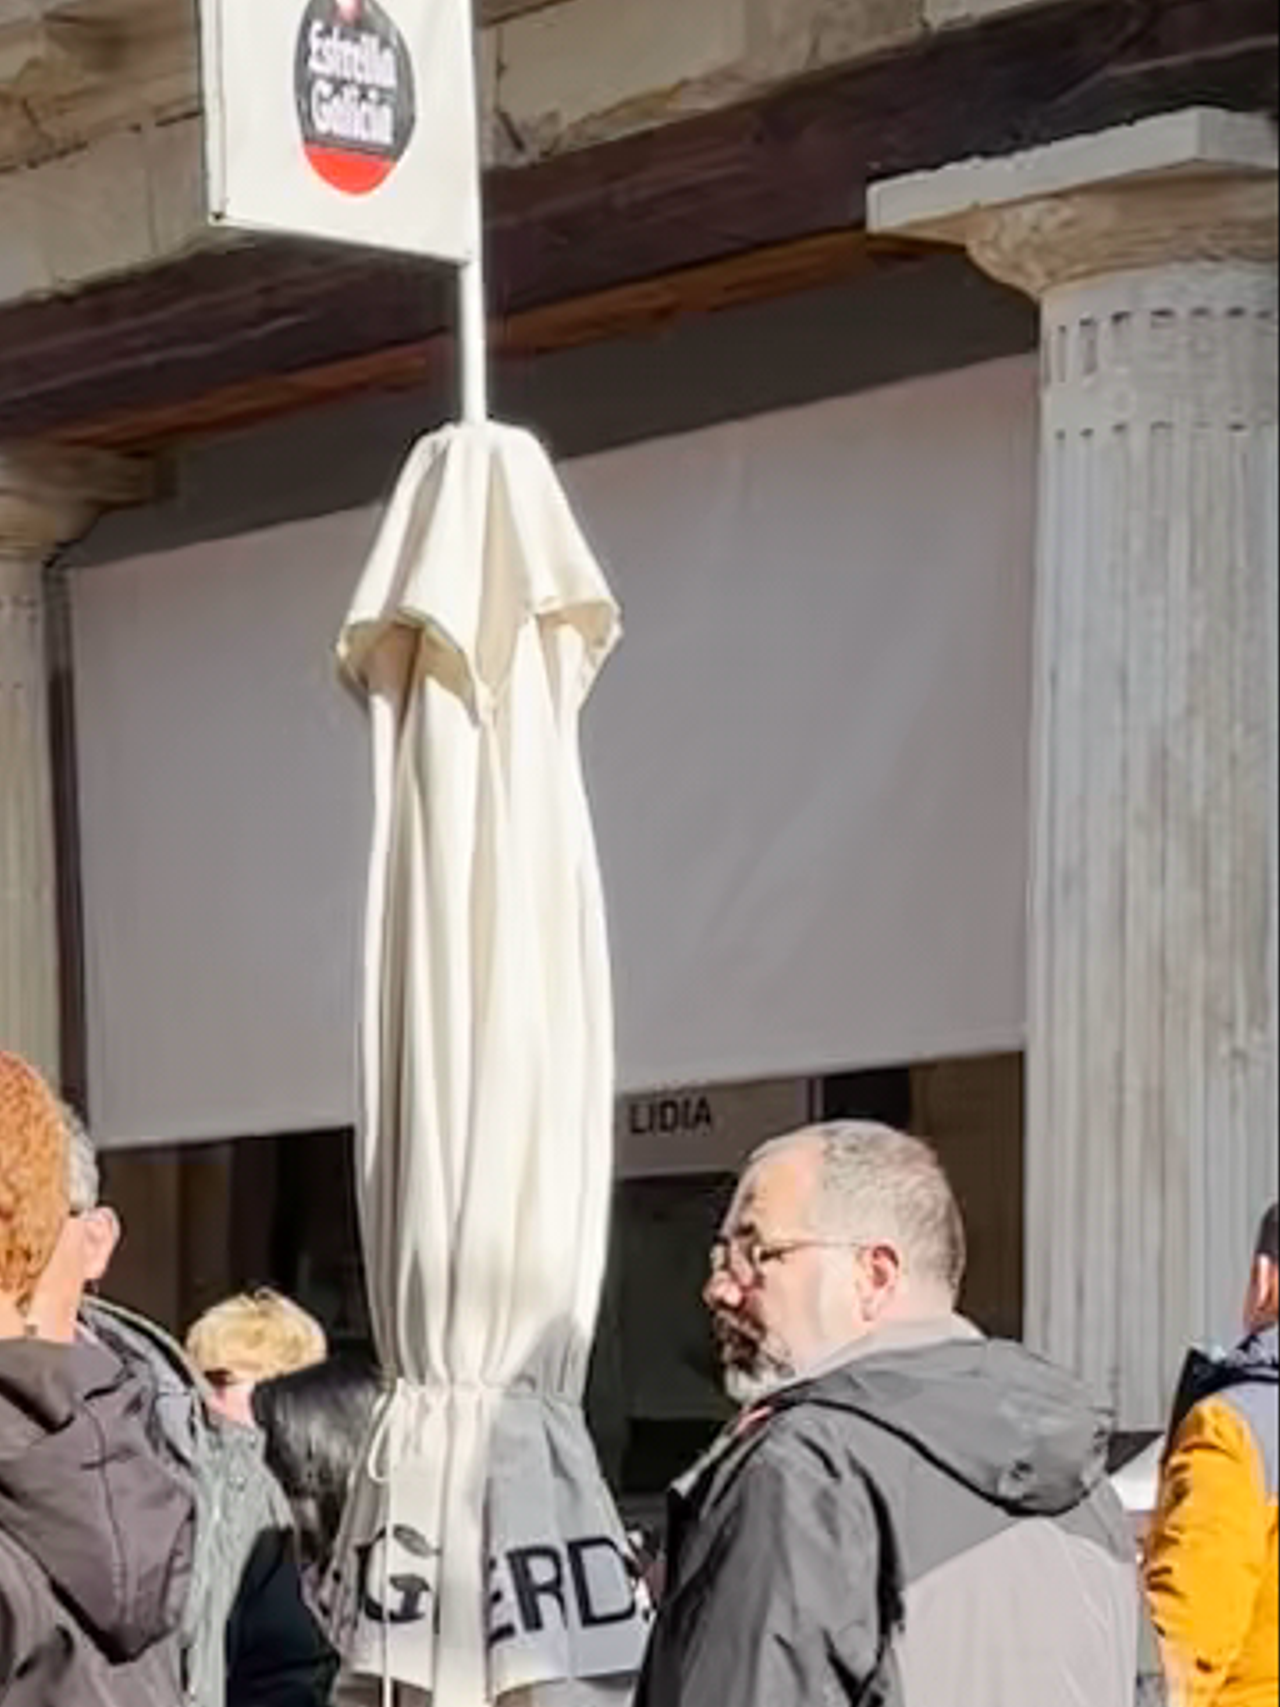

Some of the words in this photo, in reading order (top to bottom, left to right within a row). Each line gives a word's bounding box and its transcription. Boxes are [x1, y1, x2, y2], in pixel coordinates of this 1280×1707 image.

[307, 20, 398, 90] Estrella
[309, 77, 395, 147] Galicia
[629, 1096, 713, 1134] LIDIA
